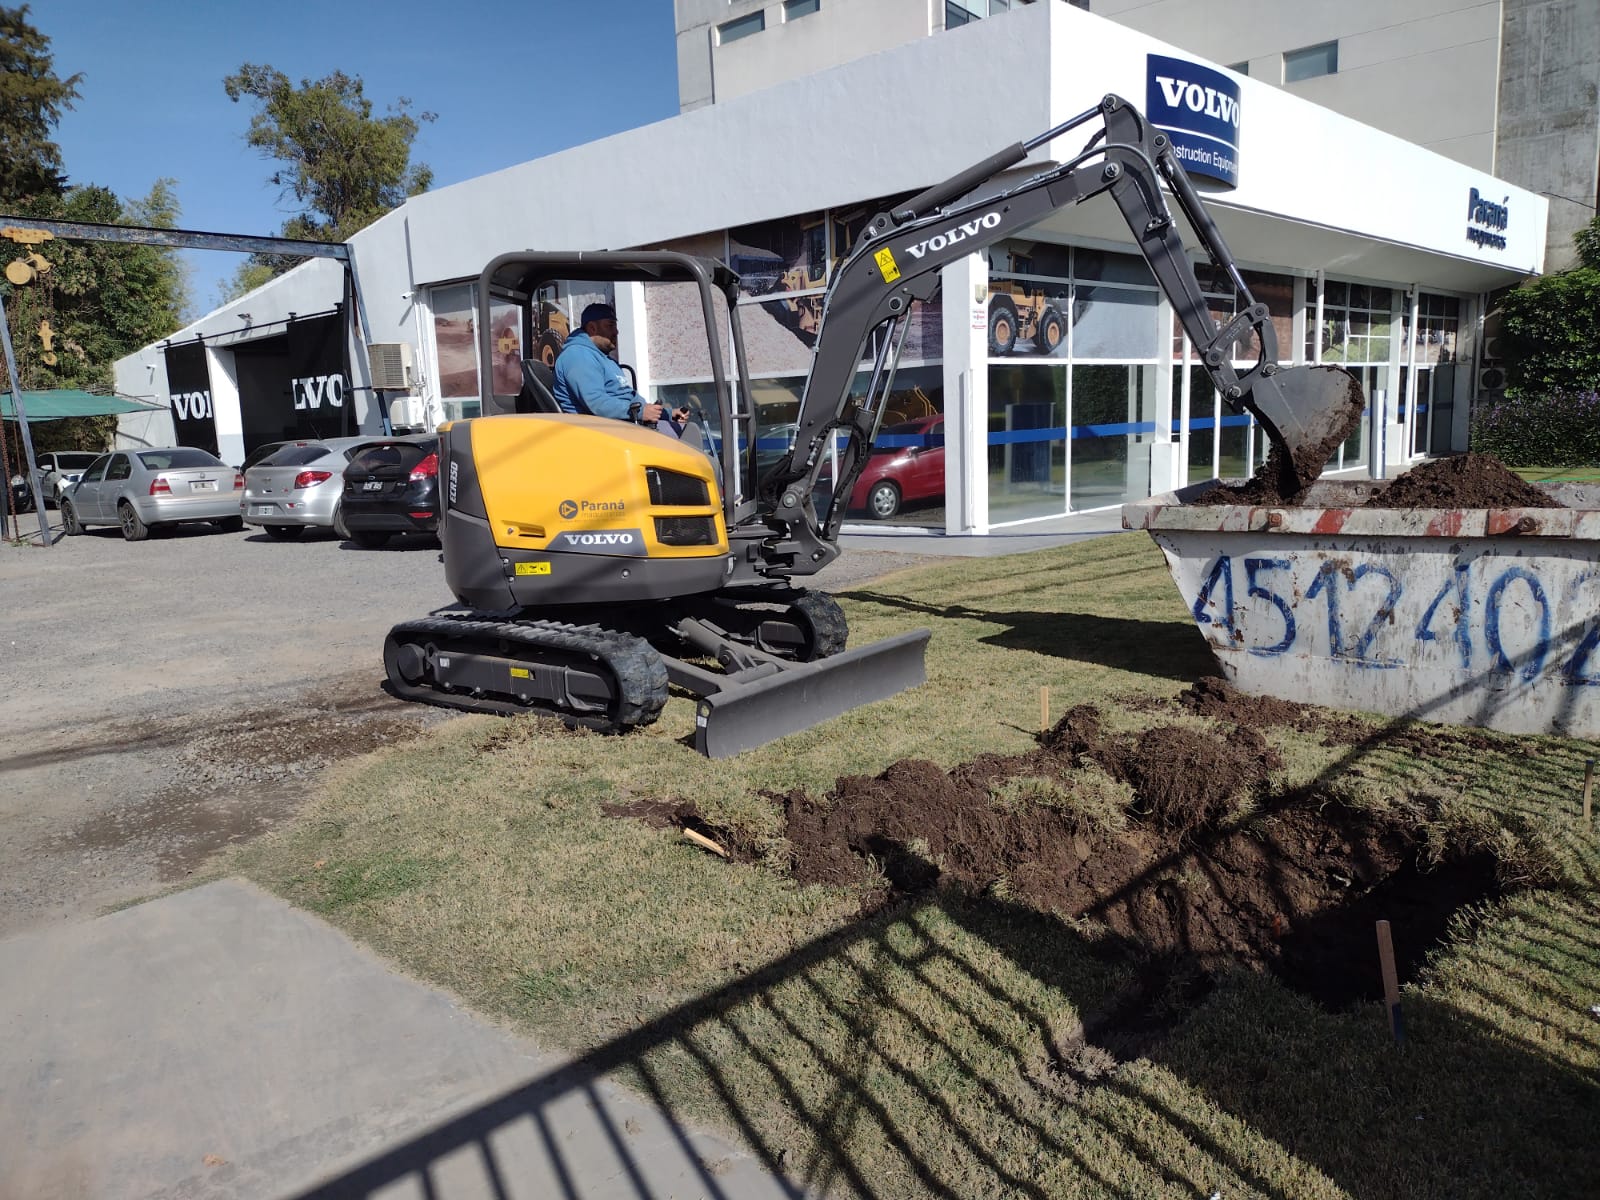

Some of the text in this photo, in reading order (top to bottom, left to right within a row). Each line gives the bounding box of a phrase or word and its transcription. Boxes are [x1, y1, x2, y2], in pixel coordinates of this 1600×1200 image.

[1156, 75, 1239, 129] VOLVO
[1172, 144, 1212, 165] struction
[1468, 187, 1509, 232] Paraná
[905, 212, 1001, 259] VOLVO
[581, 499, 625, 511] Paraná
[564, 533, 633, 545] VOLVO
